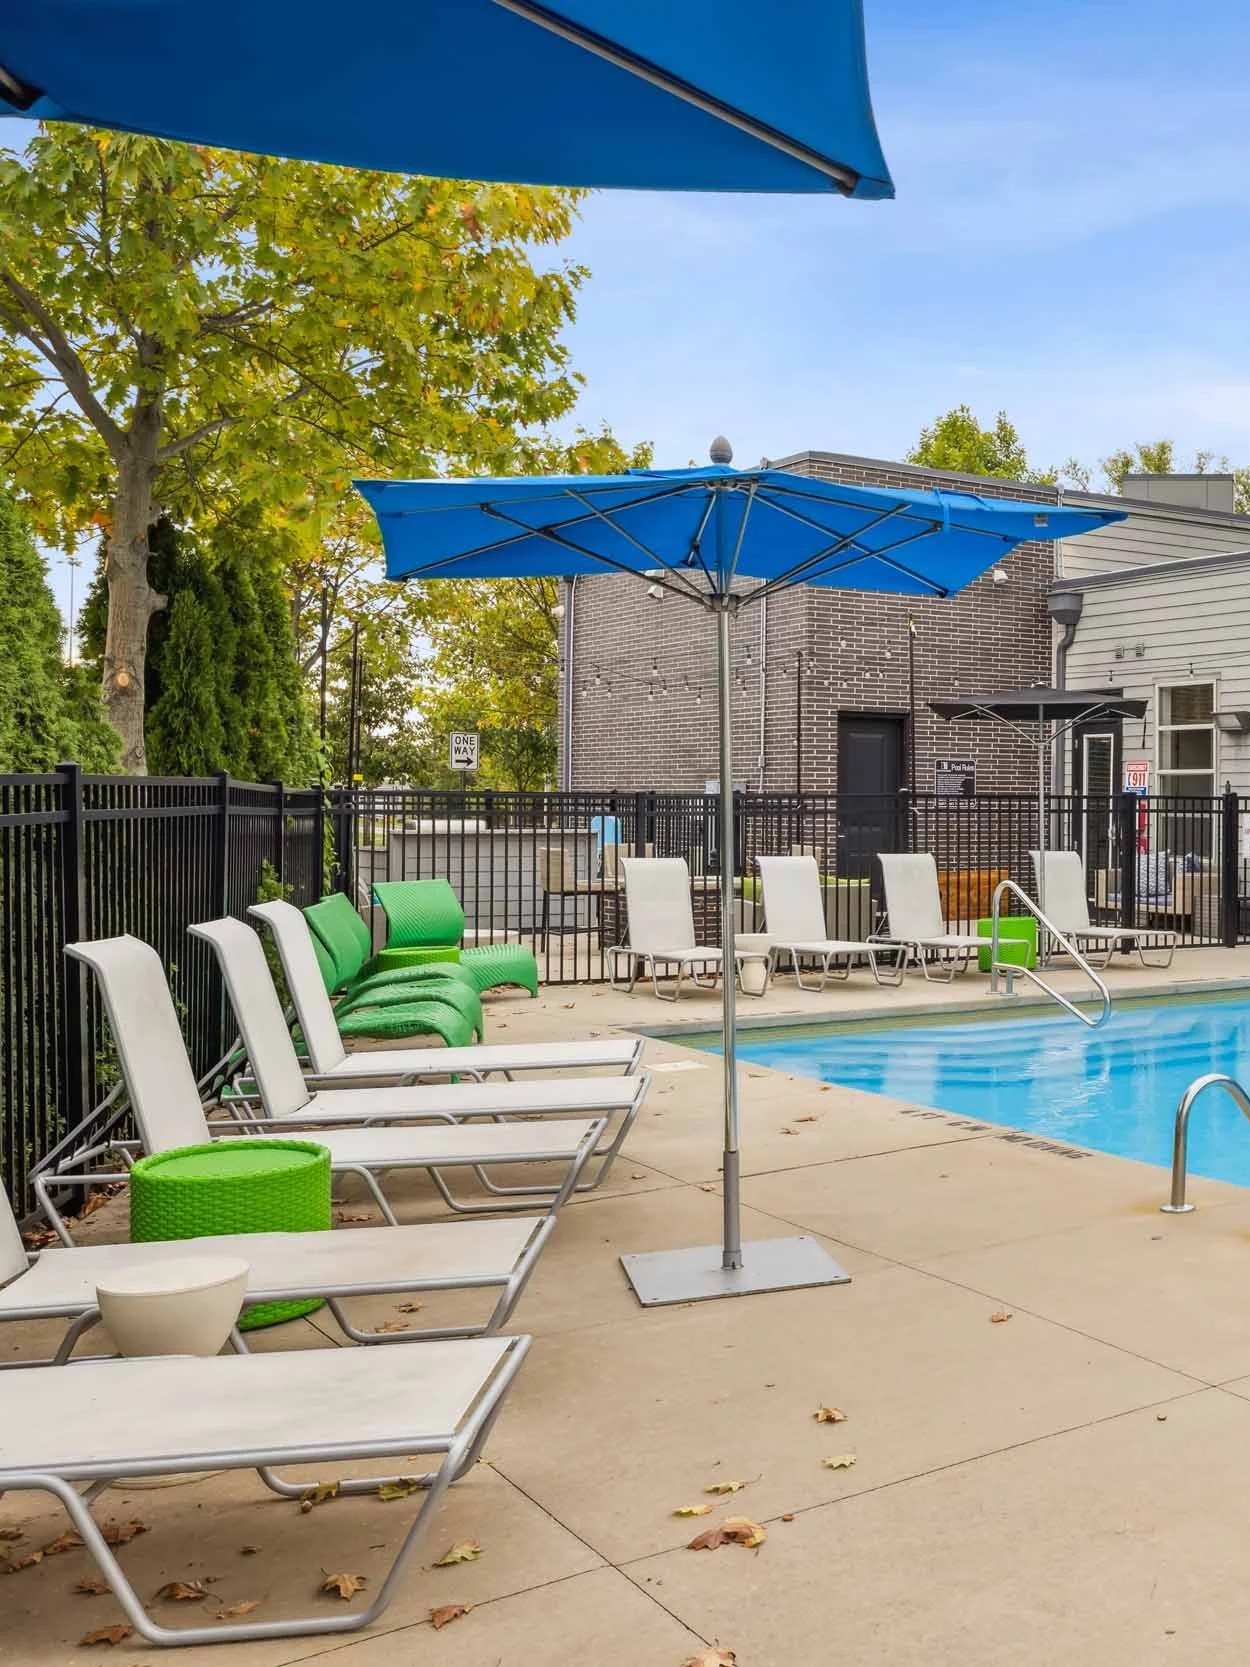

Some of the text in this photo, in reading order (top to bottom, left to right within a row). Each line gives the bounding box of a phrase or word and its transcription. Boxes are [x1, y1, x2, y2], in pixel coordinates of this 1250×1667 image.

[454, 735, 475, 746] ONE
[454, 746, 476, 756] WAY
[1132, 772, 1146, 787] 911
